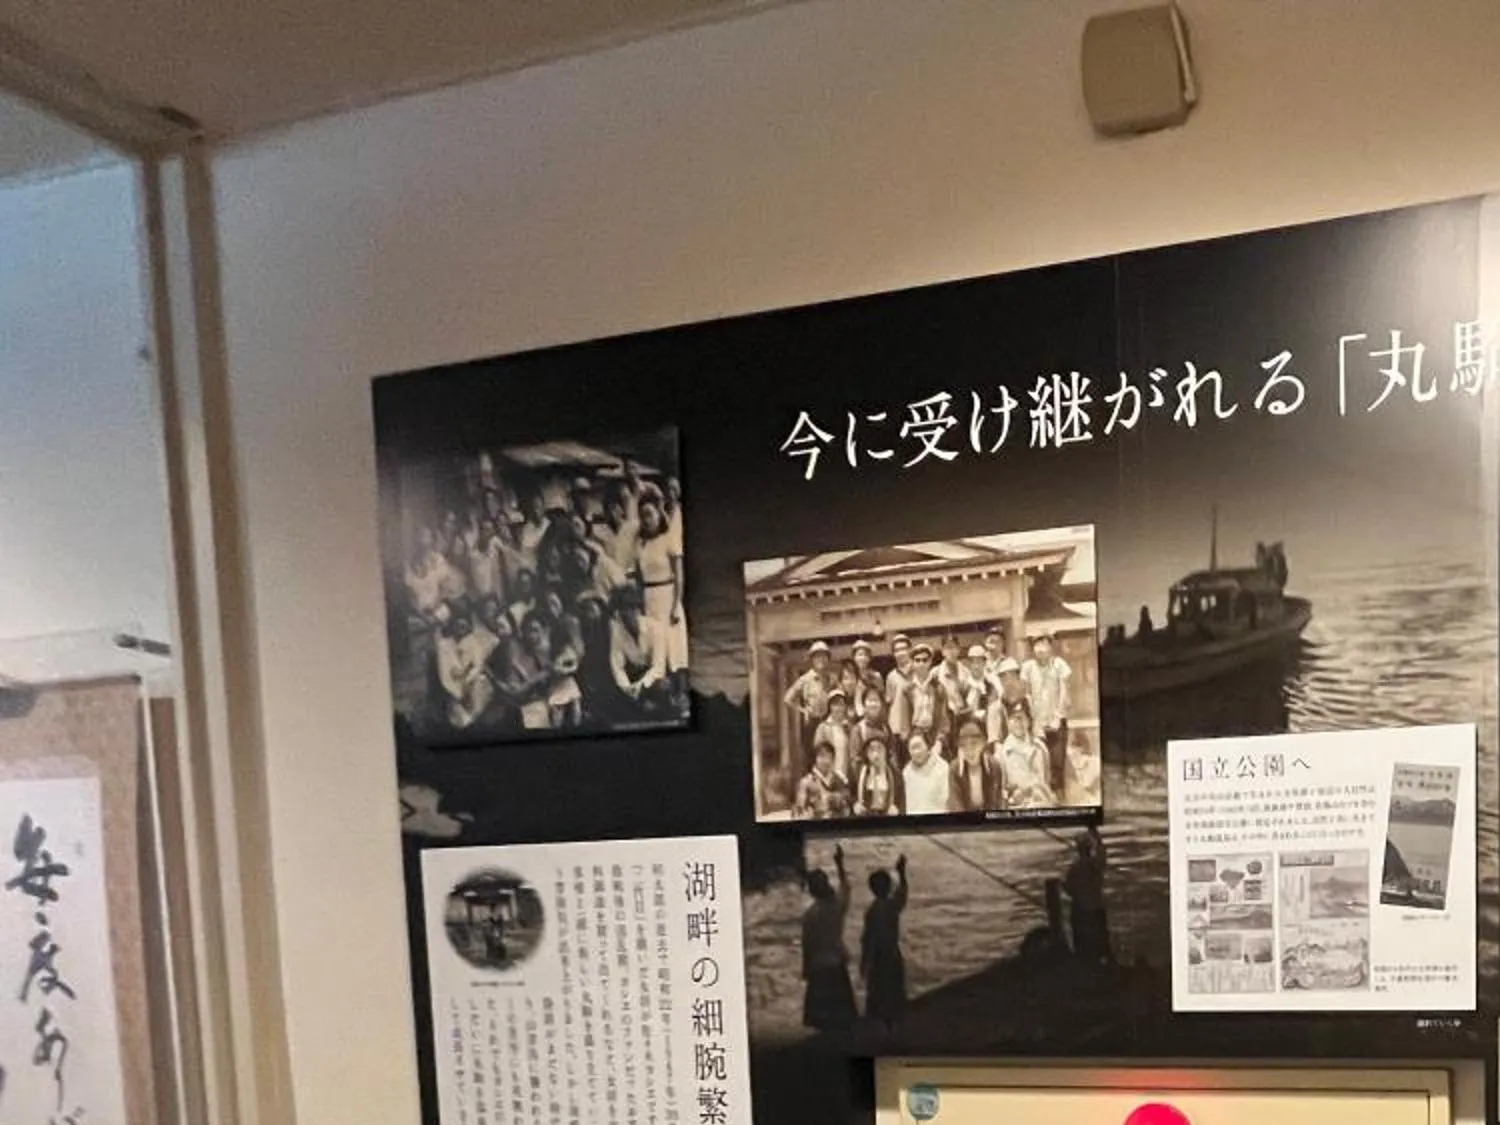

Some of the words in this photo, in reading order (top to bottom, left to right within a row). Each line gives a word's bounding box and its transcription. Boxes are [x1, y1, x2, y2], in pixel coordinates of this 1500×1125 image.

[1182, 753, 1312, 782] 国立公園へ
